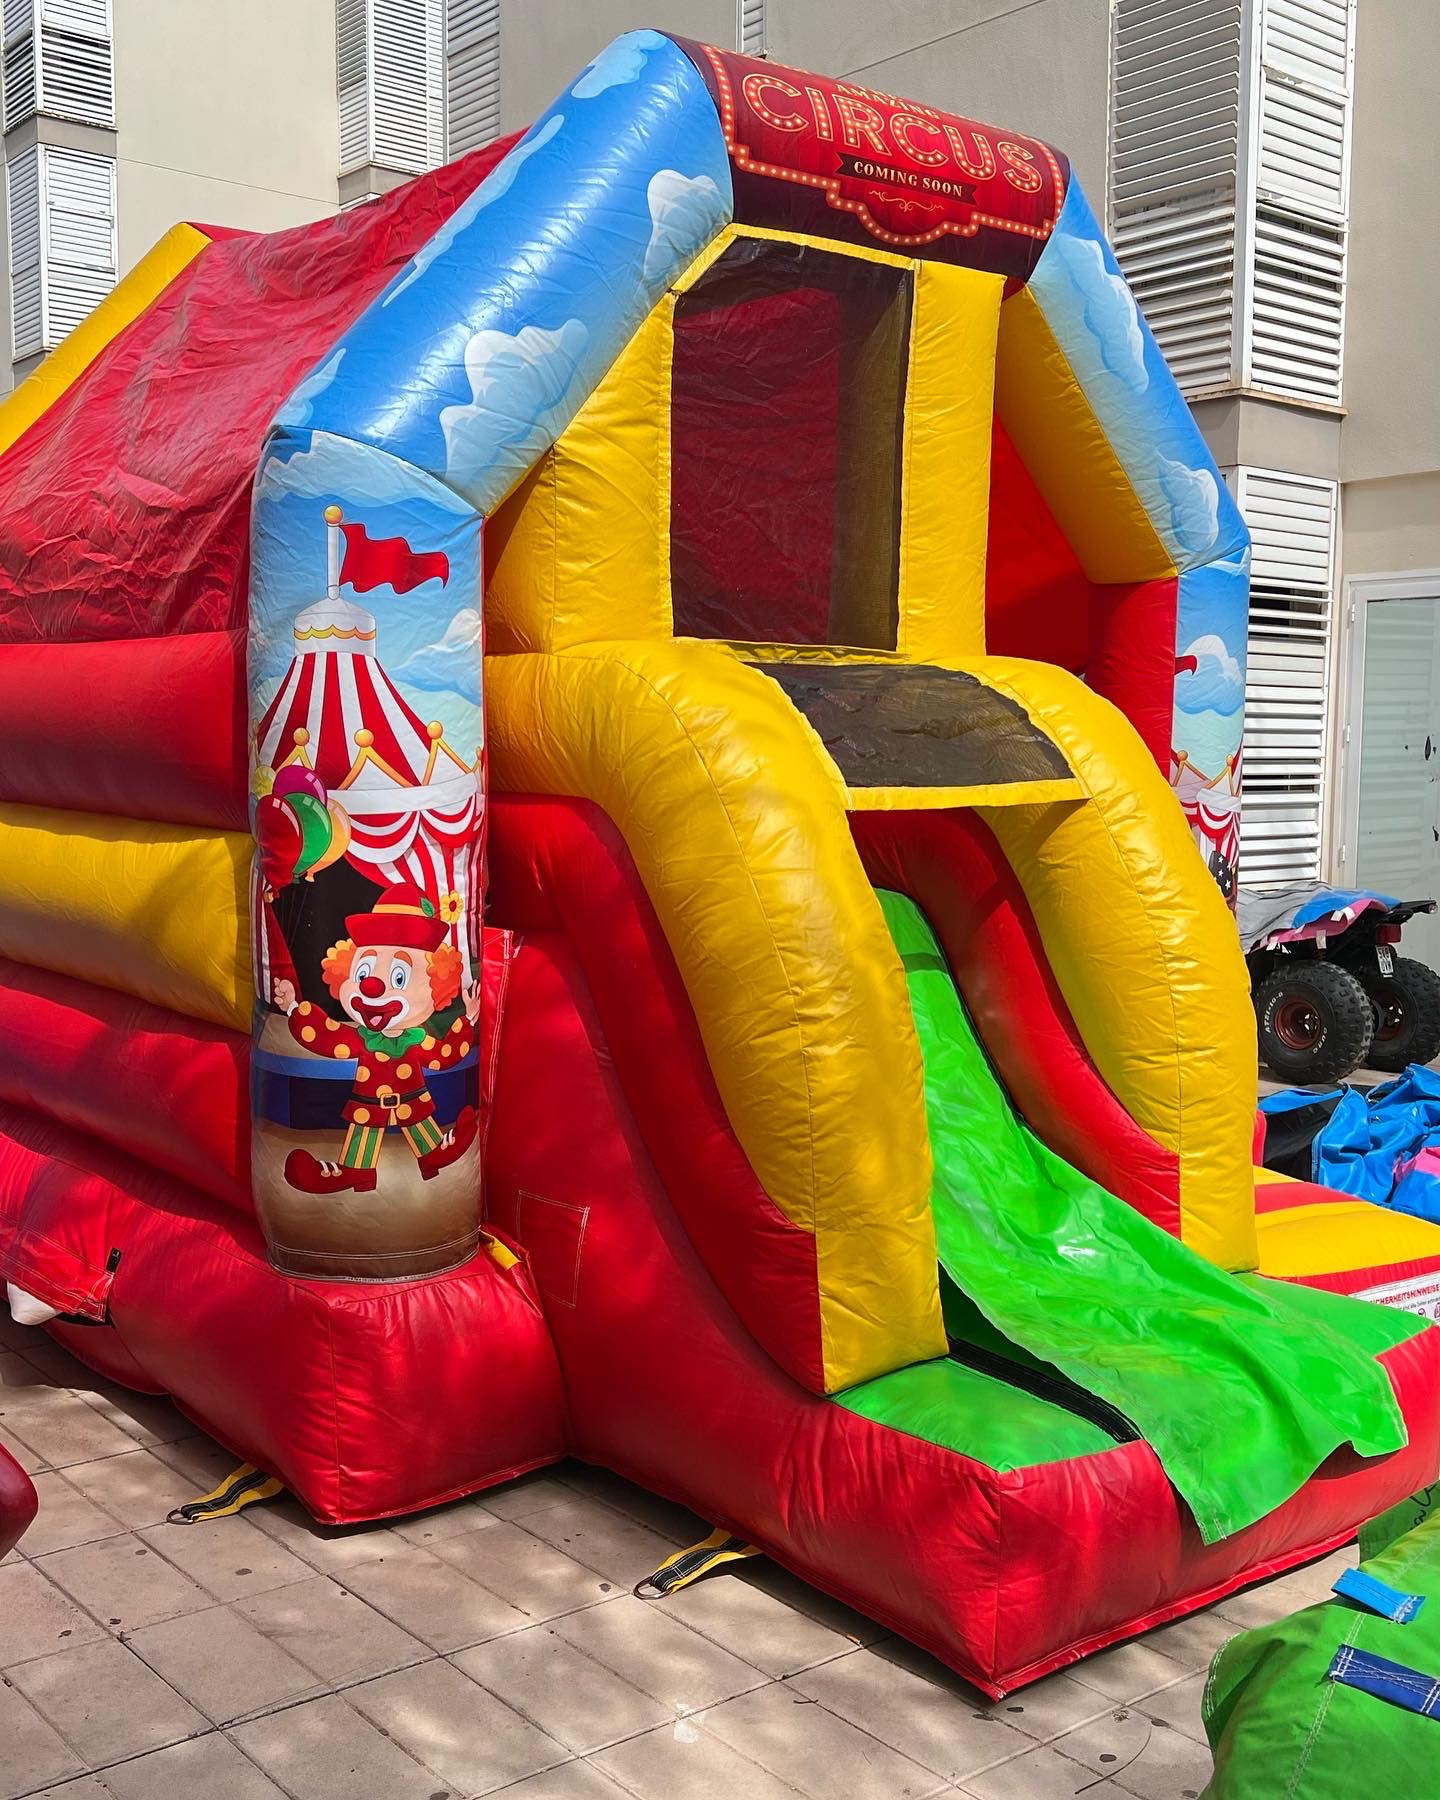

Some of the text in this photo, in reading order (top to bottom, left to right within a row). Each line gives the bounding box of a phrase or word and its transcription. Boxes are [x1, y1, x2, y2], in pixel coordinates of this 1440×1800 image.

[835, 83, 940, 120] AMAZING
[742, 73, 1044, 194] CIRCUS
[854, 161, 963, 198] COMING SOON
